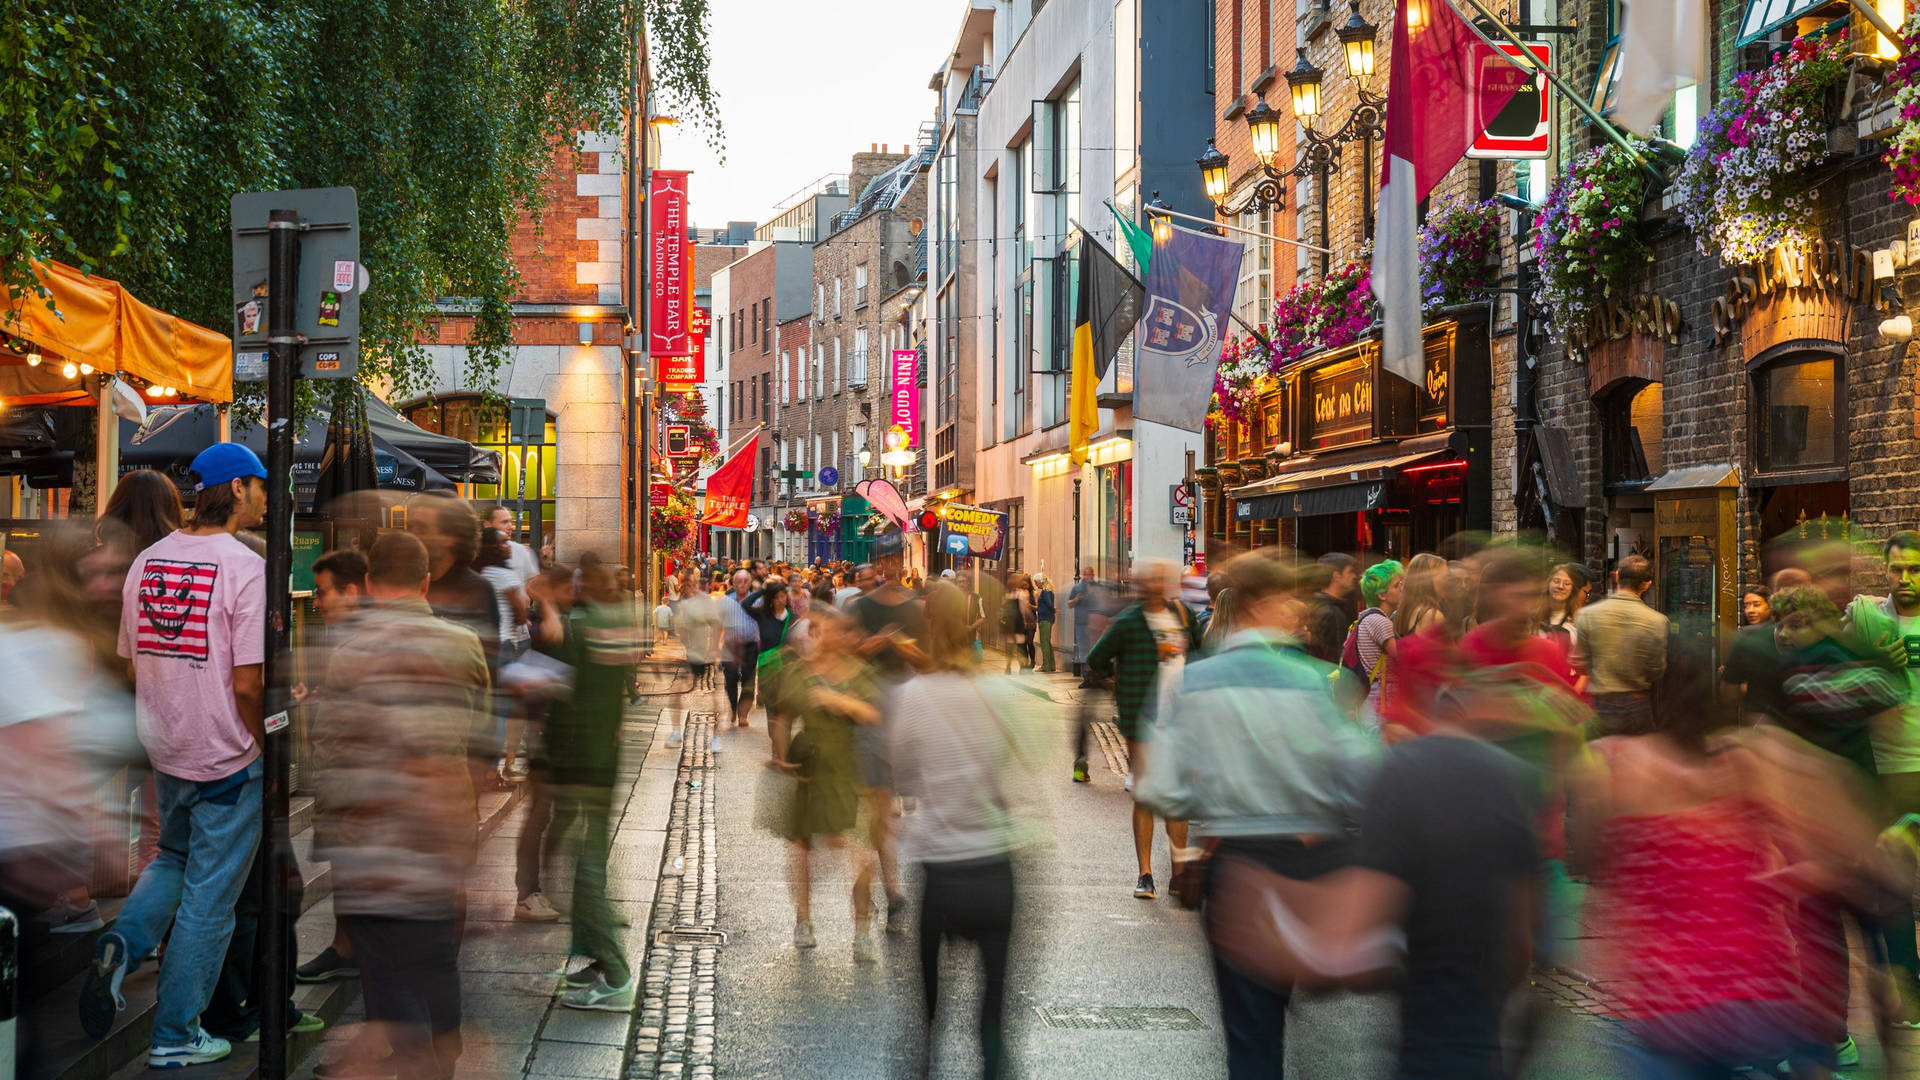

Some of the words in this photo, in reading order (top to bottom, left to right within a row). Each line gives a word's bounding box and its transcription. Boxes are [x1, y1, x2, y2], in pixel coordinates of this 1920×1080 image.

[667, 197, 680, 230] THE
[655, 230, 664, 279] TRADING
[667, 231, 680, 295] TEMPLE
[667, 299, 680, 331] BAR
[317, 361, 337, 369] COPS
[318, 353, 337, 361] COPS
[896, 353, 914, 385] NINE
[896, 390, 913, 433] CLOUD
[376, 465, 393, 474] NESS
[709, 500, 747, 511] TEMPLE
[945, 508, 1000, 525] COMEDY
[947, 521, 993, 536] TONIGHT
